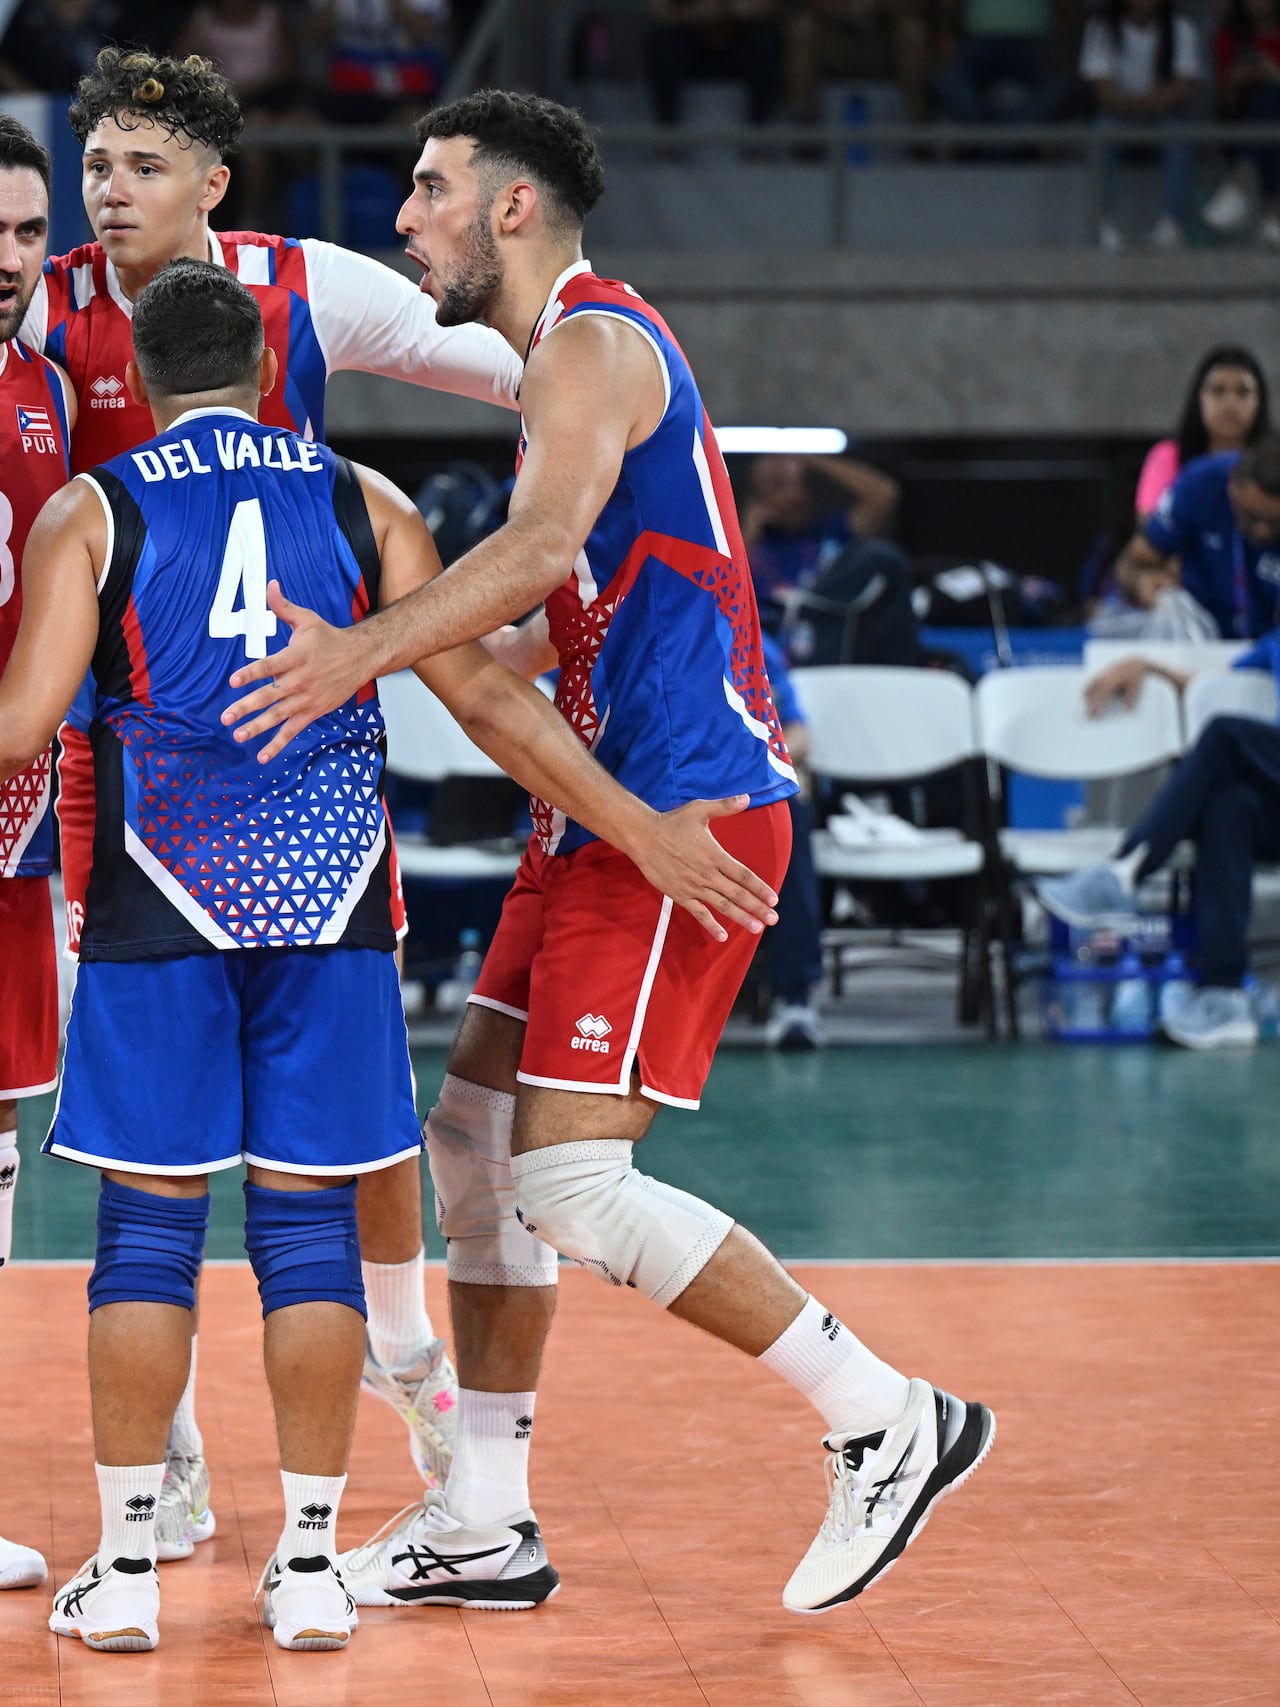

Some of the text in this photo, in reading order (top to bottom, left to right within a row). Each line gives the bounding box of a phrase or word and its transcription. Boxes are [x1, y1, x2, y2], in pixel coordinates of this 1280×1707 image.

[91, 396, 126, 409] errea
[21, 436, 58, 455] PUR
[131, 428, 323, 483] DEL VALLE
[208, 497, 277, 659] 4
[66, 900, 85, 943] 16
[570, 1036, 610, 1054] errea
